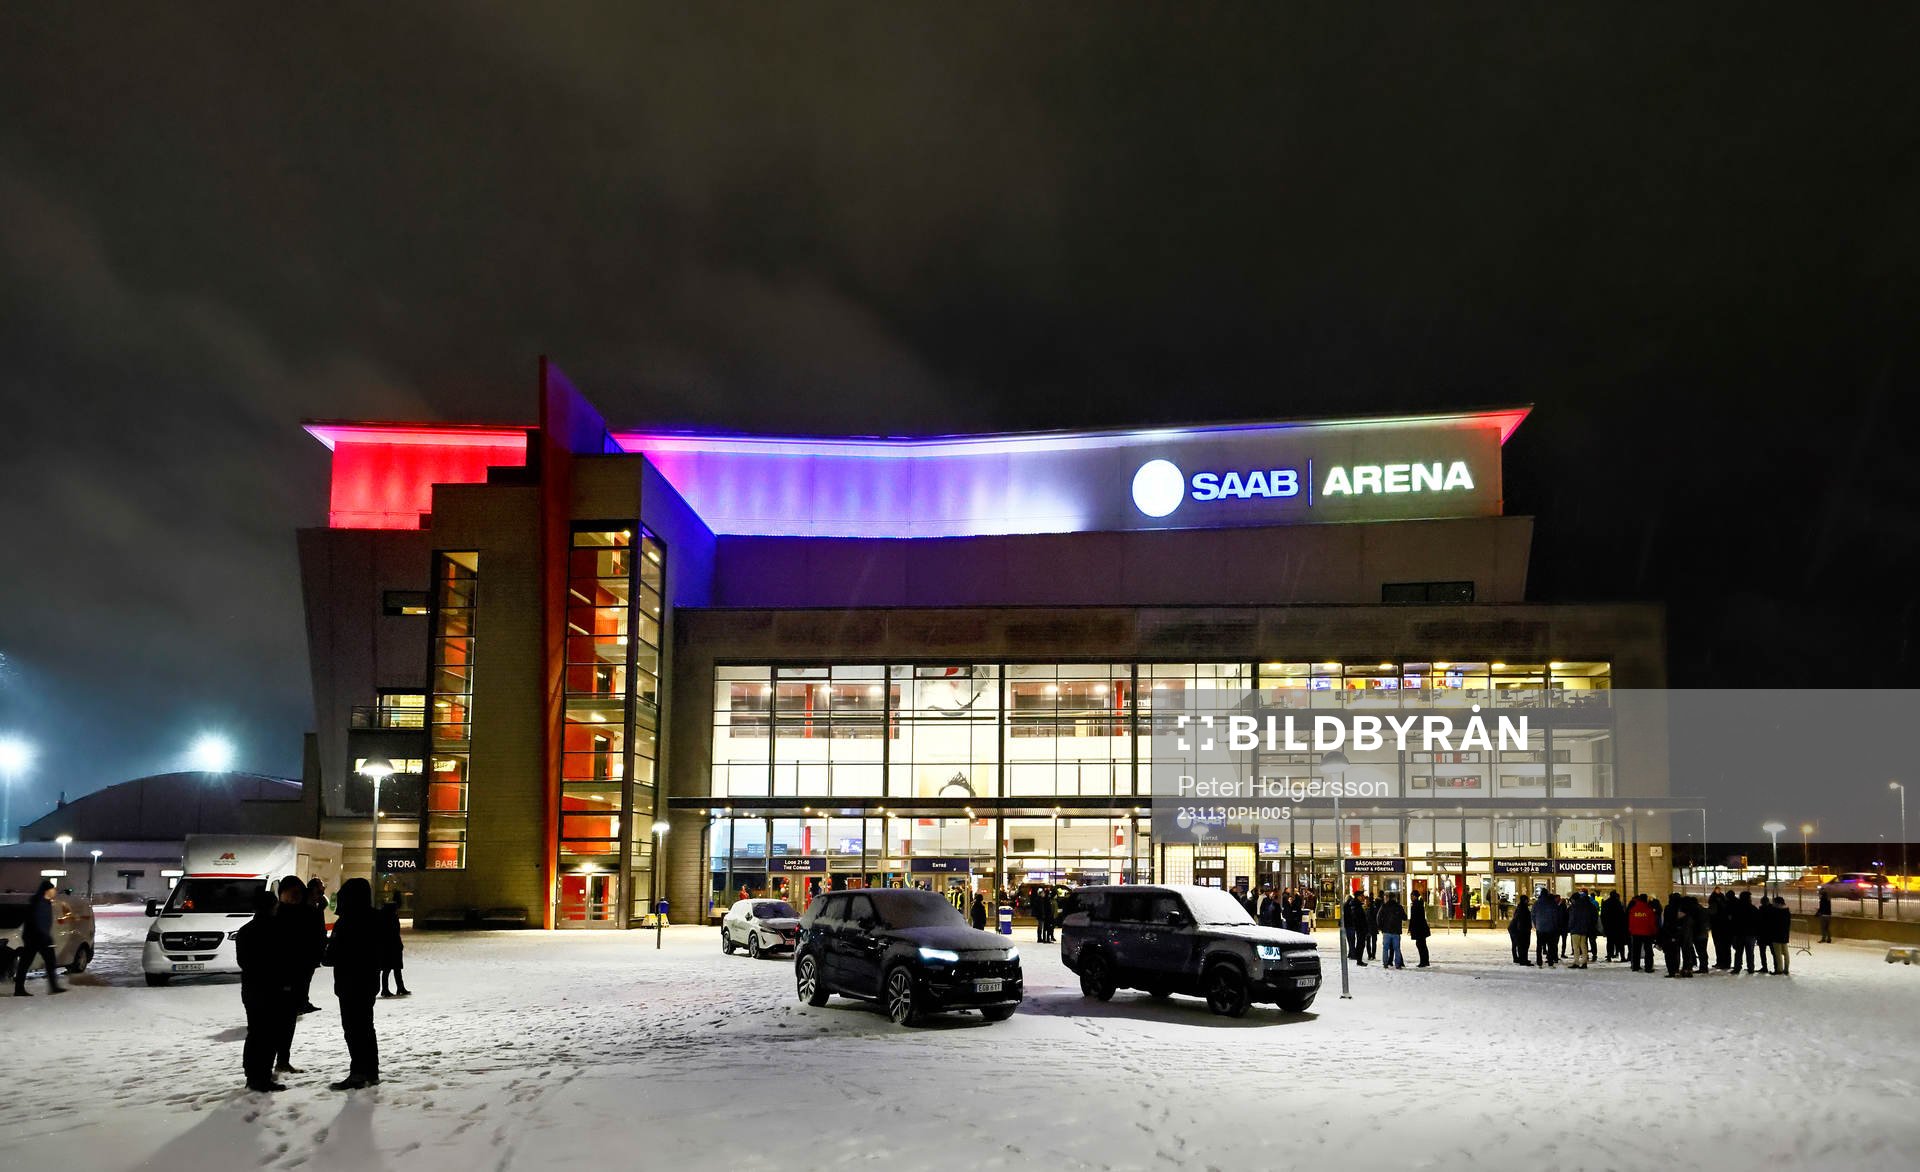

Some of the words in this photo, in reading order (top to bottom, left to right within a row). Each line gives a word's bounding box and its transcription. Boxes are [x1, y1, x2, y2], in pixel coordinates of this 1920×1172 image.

[1191, 470, 1299, 501] SAAB
[1322, 460, 1475, 496] ARENA
[387, 860, 417, 868] STORA
[1559, 863, 1612, 871] KUNDCENTER
